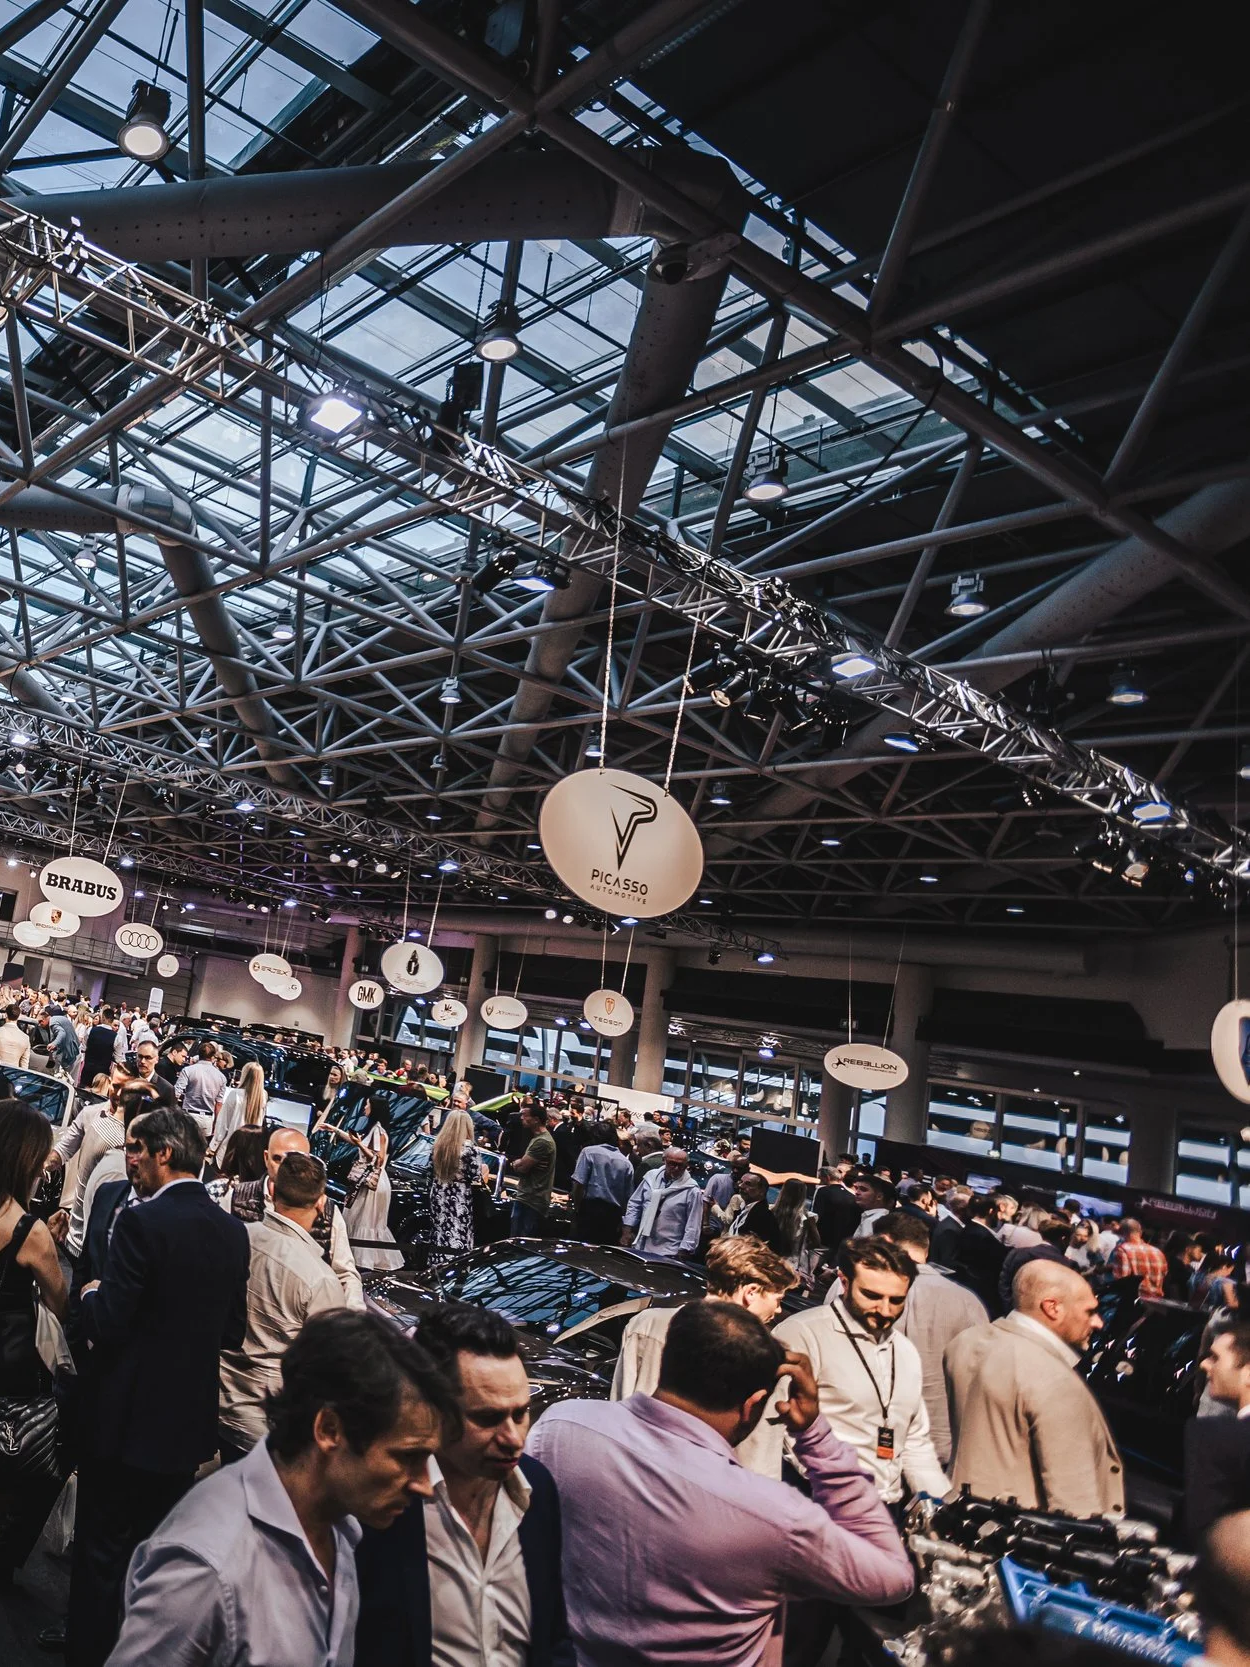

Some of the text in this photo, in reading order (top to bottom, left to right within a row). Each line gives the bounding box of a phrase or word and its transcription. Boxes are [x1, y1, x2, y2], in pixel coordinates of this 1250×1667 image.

[45, 872, 117, 901] BRABUS
[591, 868, 649, 896] PICASSO
[590, 884, 648, 905] AUTOMOTIVE
[356, 985, 377, 1004] GMK
[843, 1057, 898, 1071] REBELLION
